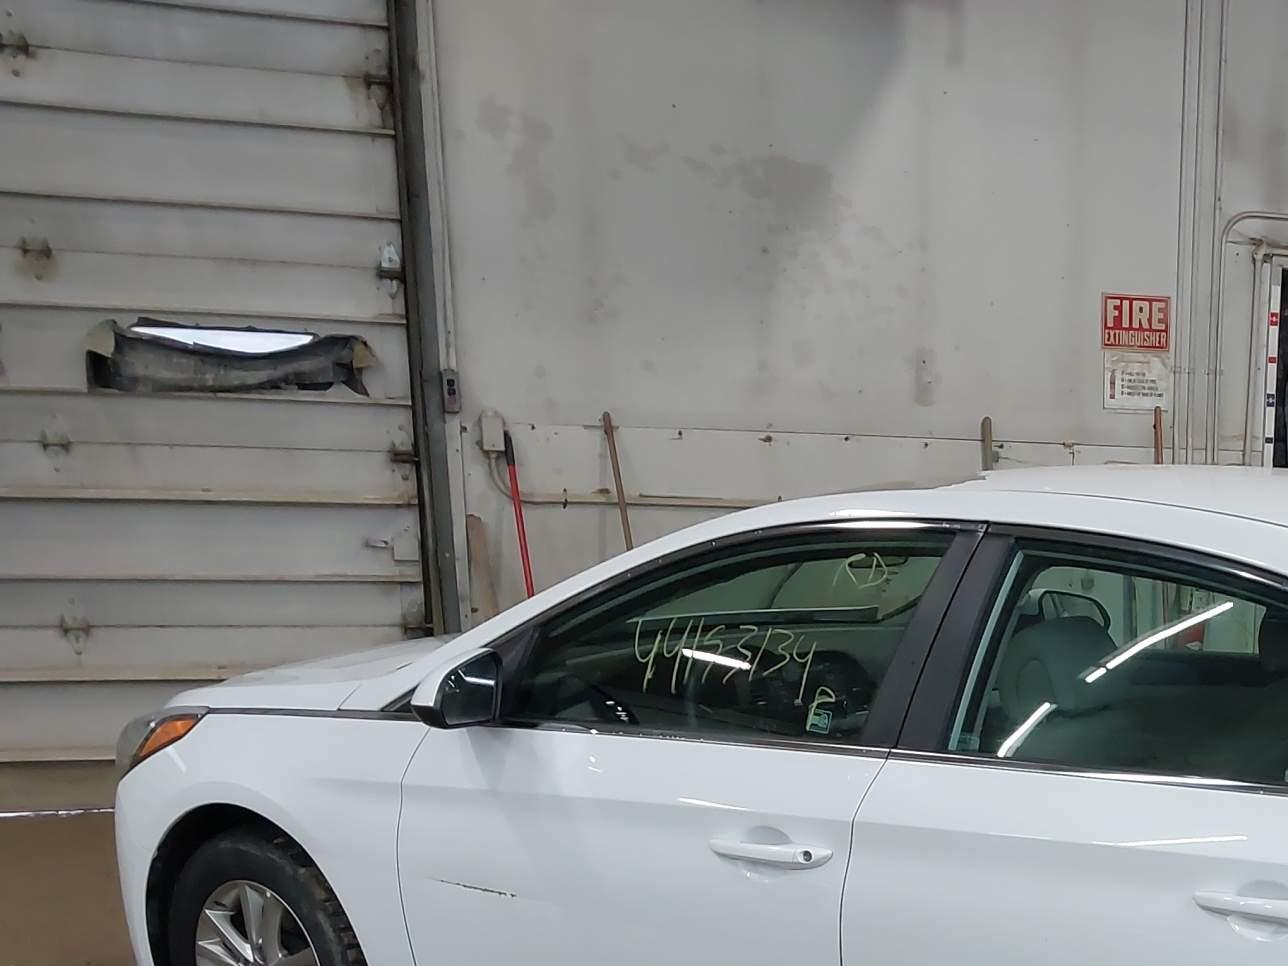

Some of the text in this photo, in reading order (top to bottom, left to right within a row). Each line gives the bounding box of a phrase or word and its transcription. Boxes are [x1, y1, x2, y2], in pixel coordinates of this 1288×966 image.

[1106, 299, 1166, 330] FIRE
[1104, 329, 1168, 348] EXTINGUISHER
[634, 617, 817, 706] 44153134
